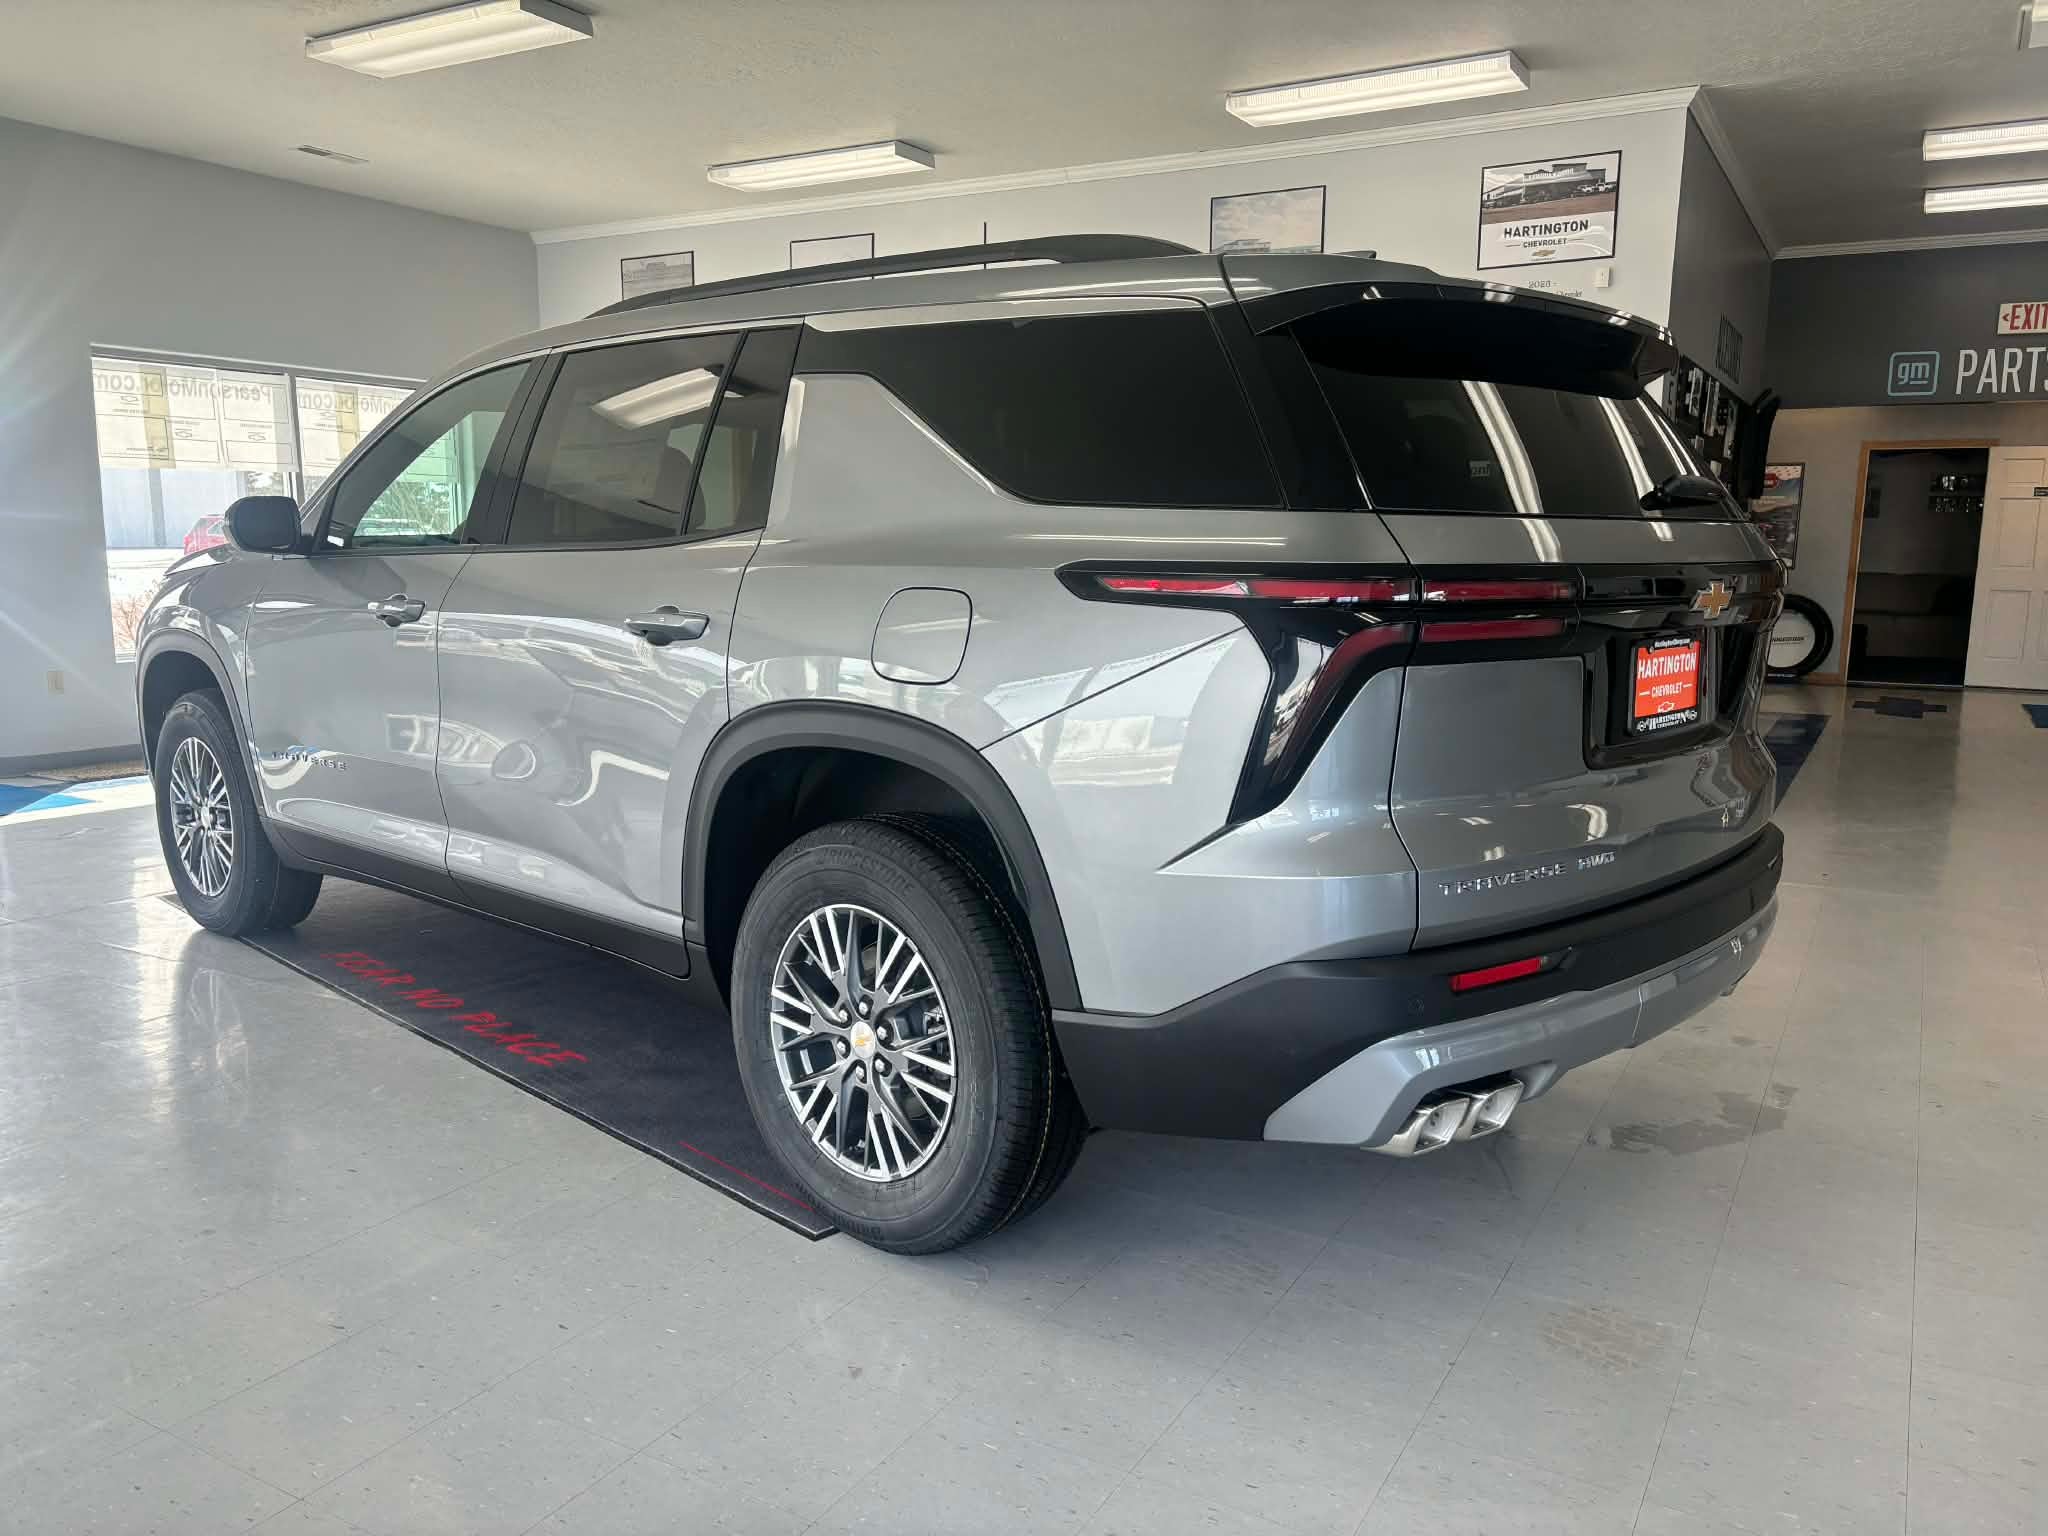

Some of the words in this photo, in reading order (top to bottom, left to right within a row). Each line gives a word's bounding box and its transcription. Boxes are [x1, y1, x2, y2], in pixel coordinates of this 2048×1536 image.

[1503, 219, 1589, 239] HARTINGTON
[1523, 238, 1567, 248] CHEVROLET
[2009, 303, 2048, 330] EXIT
[1897, 362, 1930, 385] gm
[1955, 347, 2048, 395] PART
[1637, 653, 1697, 680] HARTINGTON
[1651, 682, 1682, 698] CHEVROLET
[1438, 863, 1568, 896] TRAVERSE
[320, 952, 416, 988] FEAR
[392, 988, 465, 1009] NO
